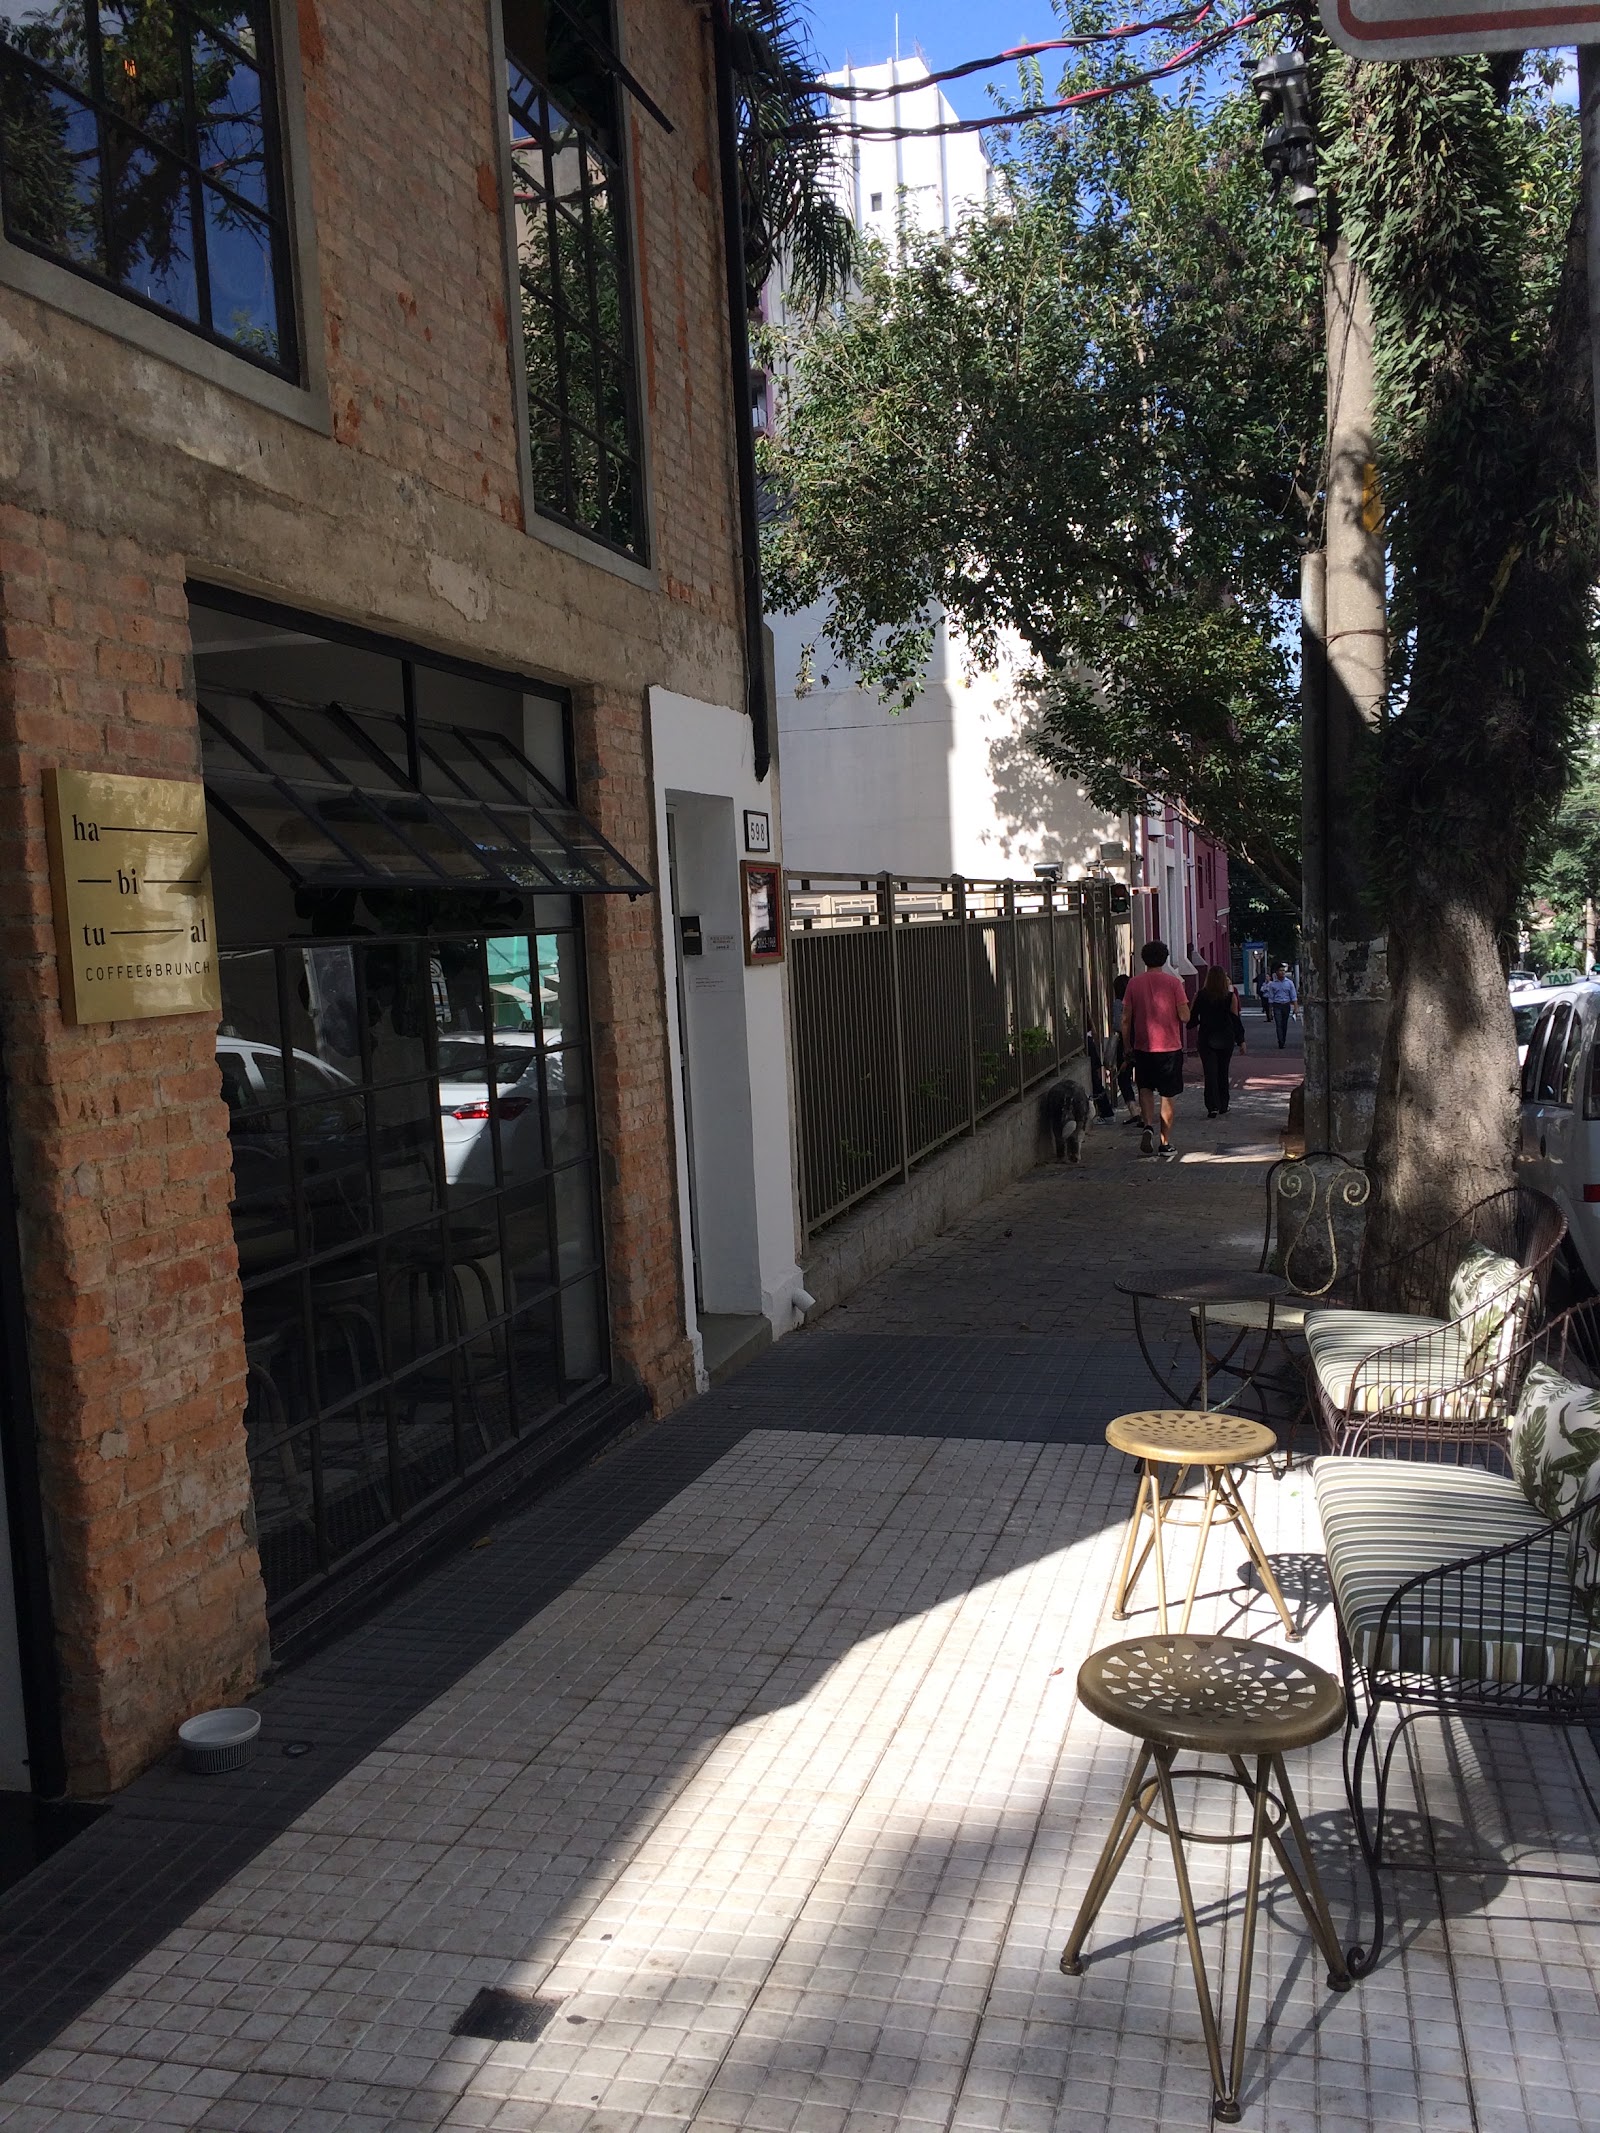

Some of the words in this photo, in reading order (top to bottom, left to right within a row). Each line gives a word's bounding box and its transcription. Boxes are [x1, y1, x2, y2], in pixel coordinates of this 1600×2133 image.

[72, 814, 100, 842] ha
[750, 822, 765, 841] 598
[117, 868, 138, 895] bi
[82, 923, 106, 946] tu
[190, 918, 207, 943] al
[1546, 973, 1573, 985] TAXI
